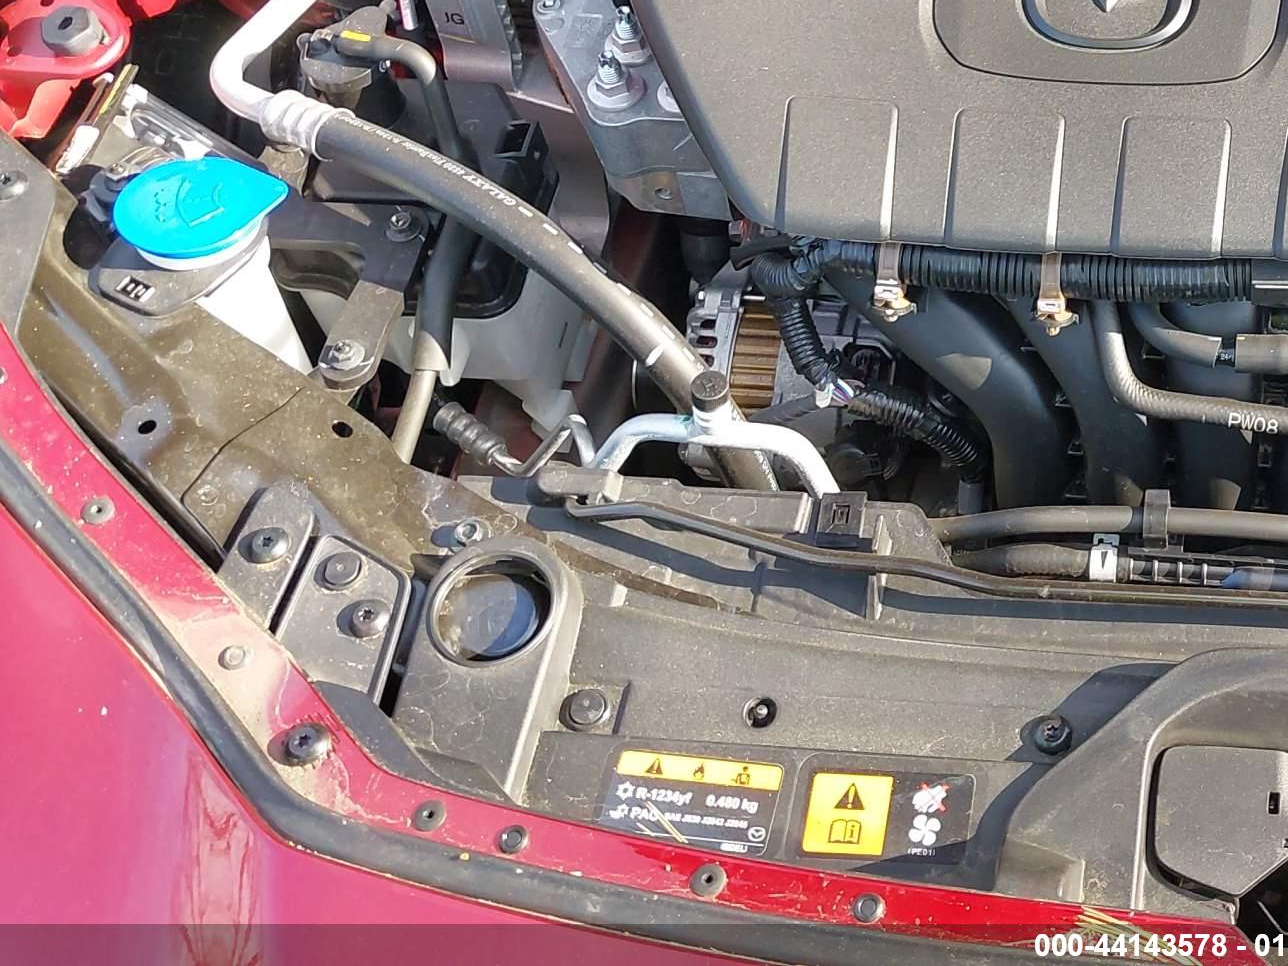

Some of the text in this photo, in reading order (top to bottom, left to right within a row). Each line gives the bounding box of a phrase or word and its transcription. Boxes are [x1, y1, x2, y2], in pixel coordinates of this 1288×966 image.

[461, 174, 517, 206] GALAXY
[1228, 412, 1278, 434] PW08
[635, 786, 693, 806] R-1234yf
[741, 797, 759, 813] kg
